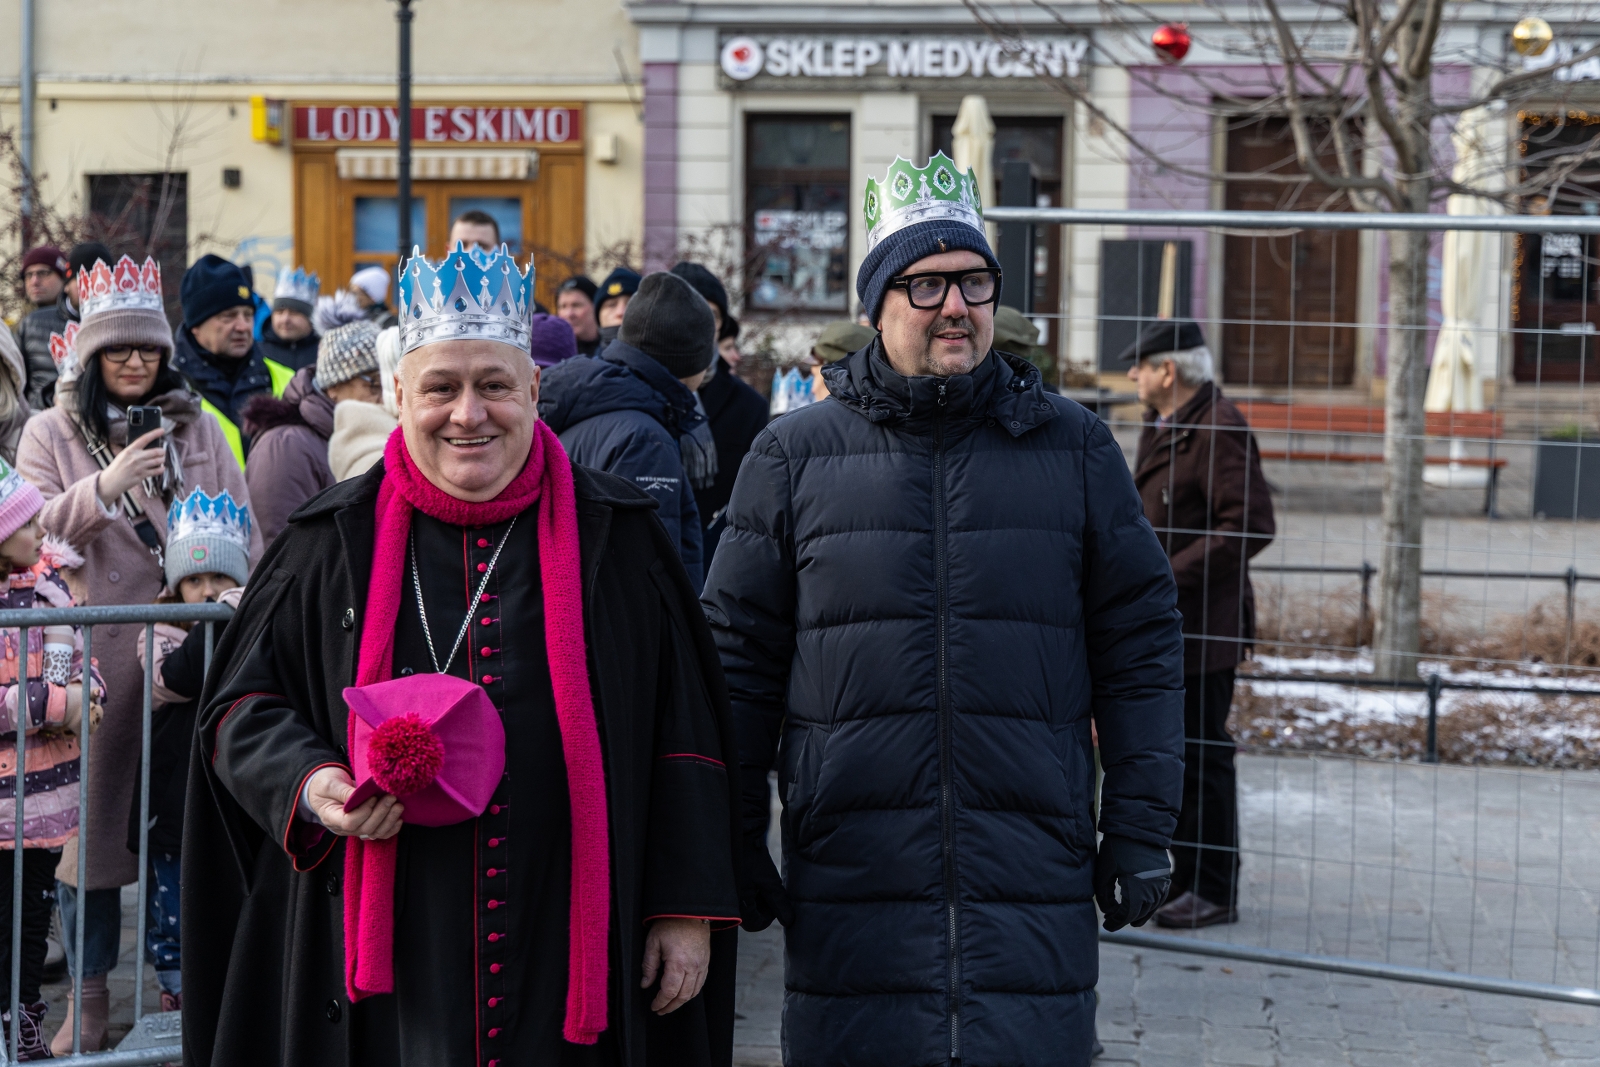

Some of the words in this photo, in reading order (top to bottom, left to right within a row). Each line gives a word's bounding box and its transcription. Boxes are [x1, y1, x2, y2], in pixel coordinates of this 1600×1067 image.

[765, 40, 882, 77] SKLEP
[887, 40, 1088, 78] MEDYCZNY
[307, 105, 401, 141] LODY
[425, 106, 570, 143] ESKIMO
